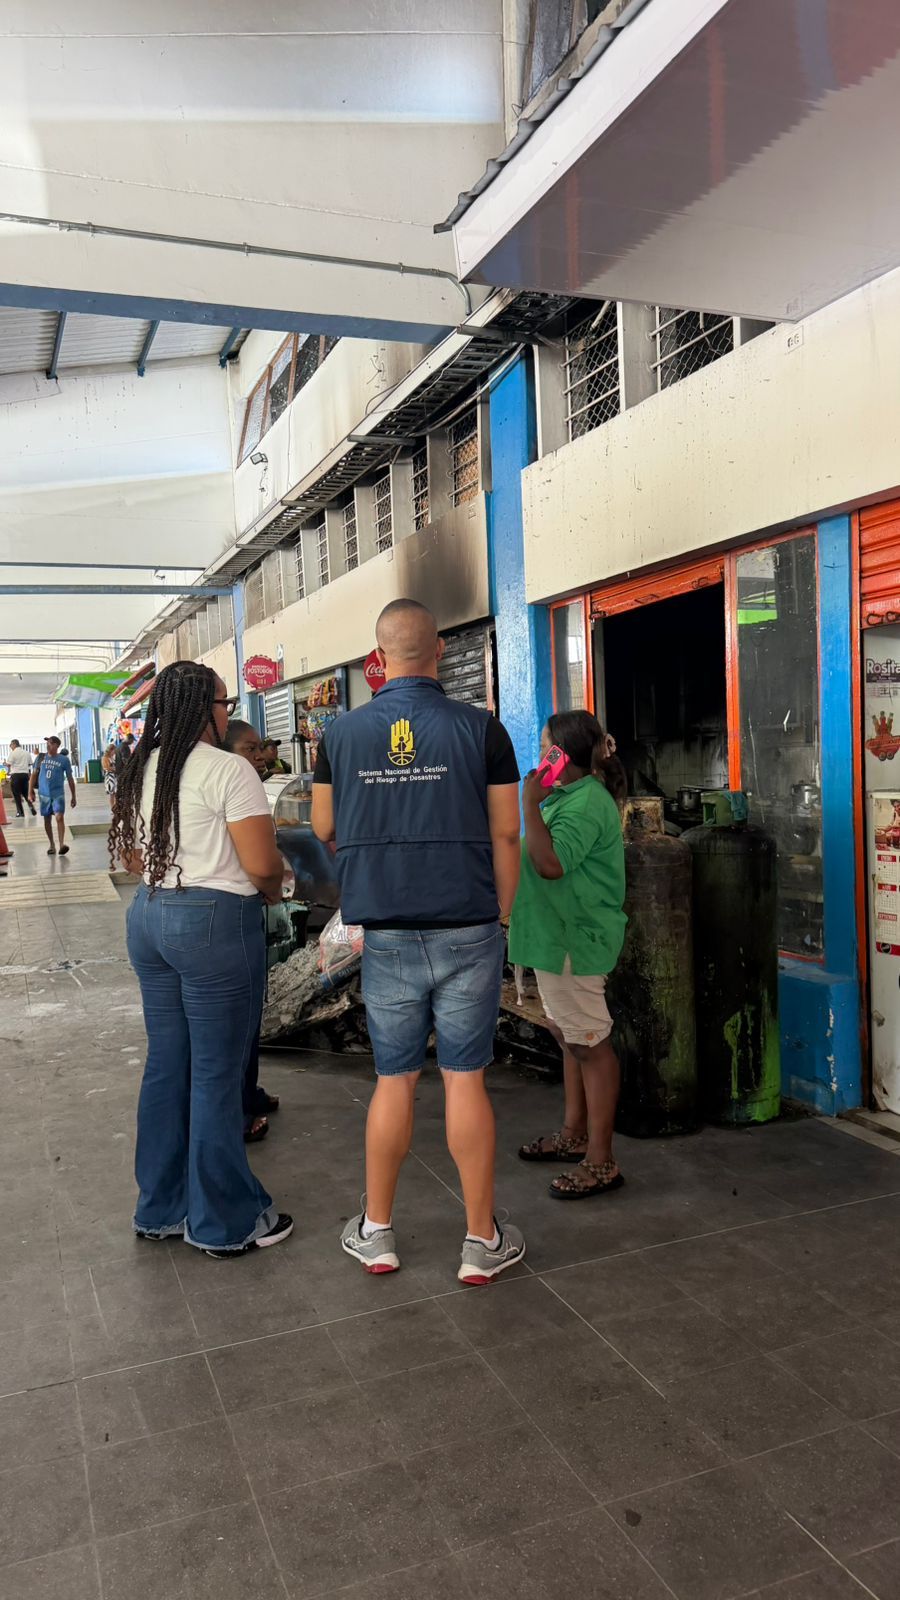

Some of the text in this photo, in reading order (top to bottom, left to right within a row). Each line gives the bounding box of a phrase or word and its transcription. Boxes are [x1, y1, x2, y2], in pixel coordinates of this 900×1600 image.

[46, 770, 52, 779] 0
[385, 767, 410, 776] Nacional
[423, 764, 448, 773] Gestión
[376, 776, 397, 784] Riesgo
